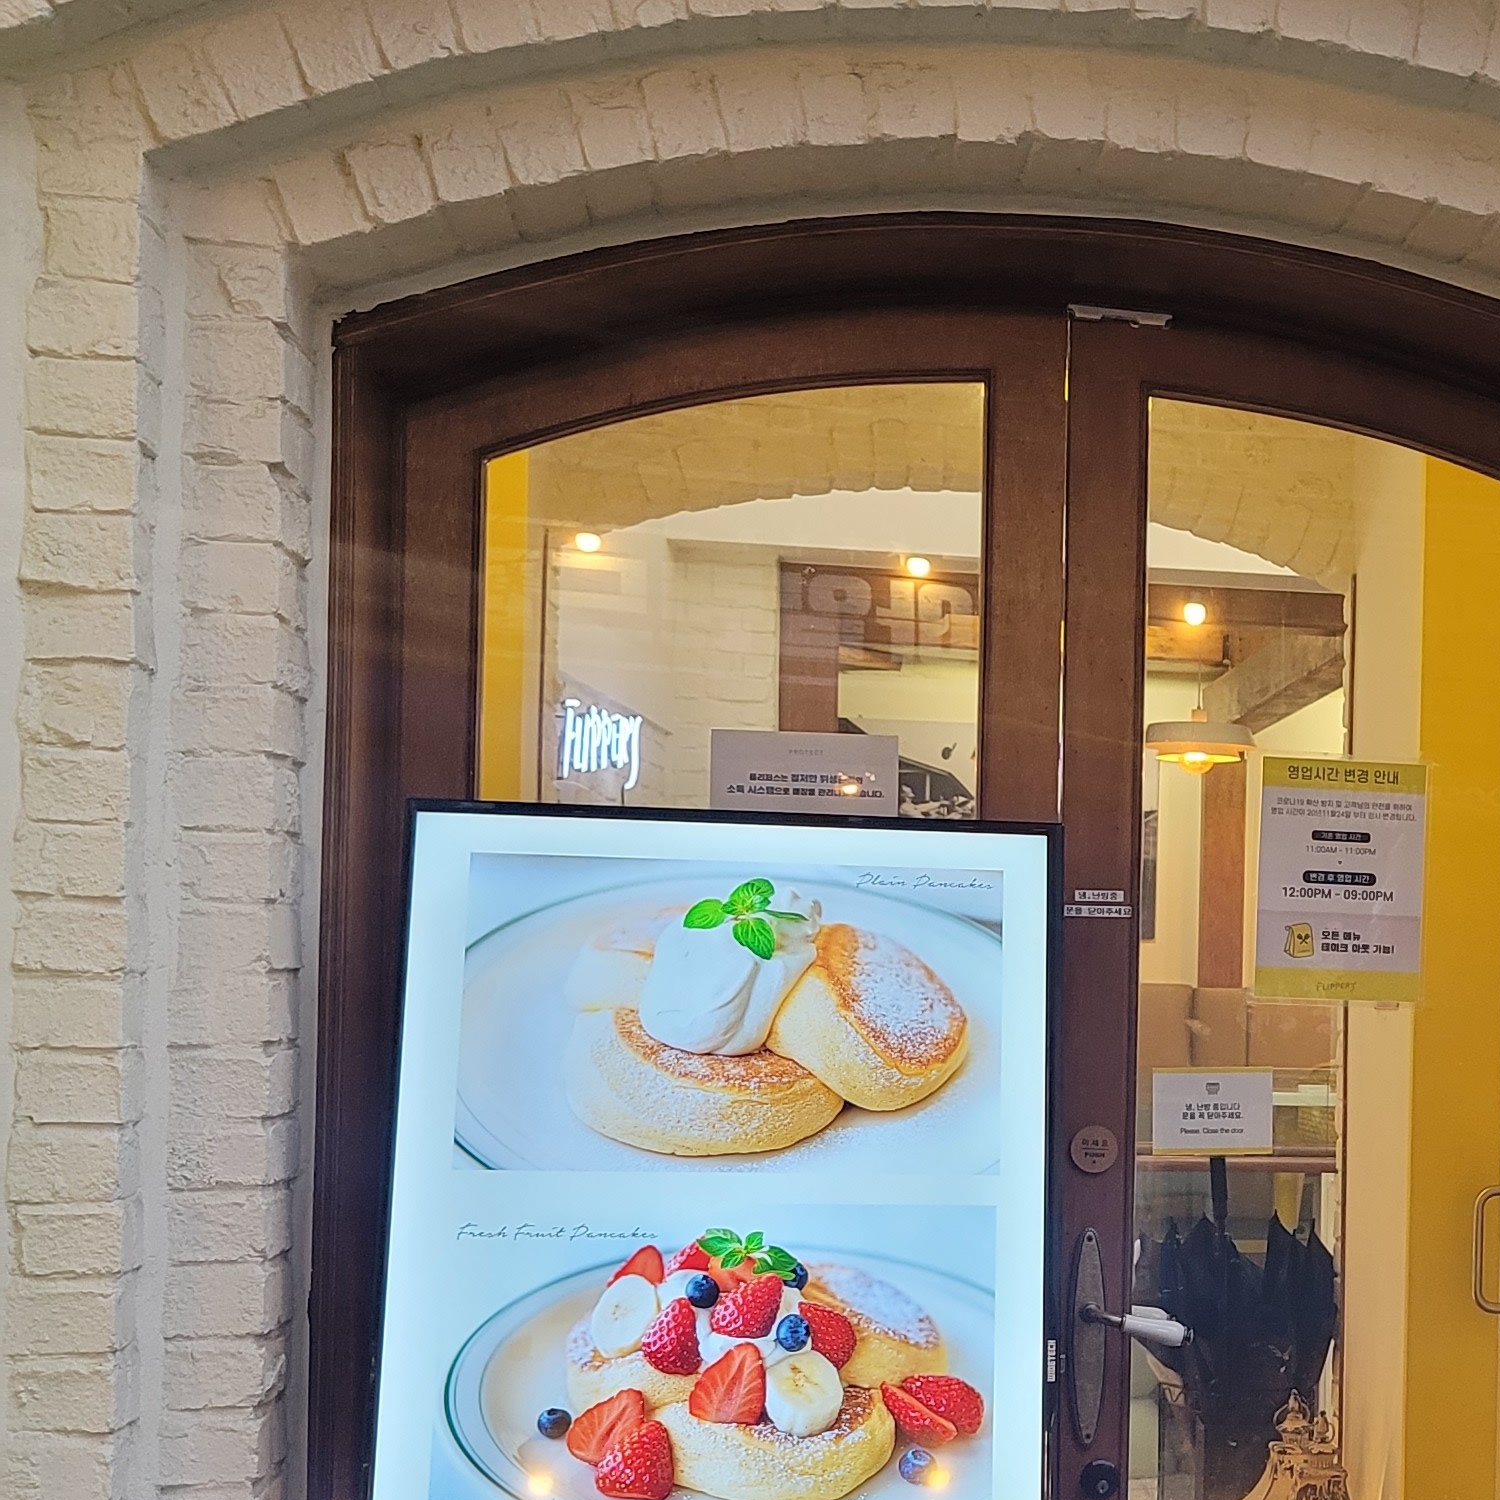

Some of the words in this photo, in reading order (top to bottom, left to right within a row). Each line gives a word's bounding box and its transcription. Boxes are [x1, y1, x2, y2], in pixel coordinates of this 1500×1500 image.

[749, 773, 789, 782] 플리퍼스는
[1287, 764, 1340, 782] 영업시간
[1344, 768, 1369, 784] 변경
[1373, 769, 1400, 785] 안내
[727, 784, 745, 794] 소독
[747, 786, 790, 795] 시스템으로
[1277, 797, 1304, 806] 코로나19
[1306, 798, 1319, 807] 확산
[1321, 799, 1334, 808] 방지
[1344, 801, 1370, 809] 고객님의
[1271, 807, 1284, 815] 영업
[1321, 832, 1333, 840] 기존
[1306, 845, 1337, 854] 11:00AM
[1345, 847, 1376, 855] 11:00PM
[855, 871, 907, 888] Plain
[912, 873, 995, 890] Pancakes
[1310, 873, 1325, 882] 변경
[1327, 873, 1334, 882] 후
[1337, 874, 1352, 883] 영업
[1354, 875, 1370, 883] 시간
[1282, 887, 1332, 899] 12:00PM
[1343, 889, 1394, 902] 09:00PM
[1066, 906, 1082, 915] 문을
[1321, 931, 1339, 941] 모든
[1343, 931, 1361, 941] 메뉴
[1321, 943, 1348, 953] 테이크
[1352, 944, 1370, 954] 아웃
[1373, 944, 1395, 954] 가능!
[1196, 1103, 1211, 1111] 난방
[1212, 1103, 1240, 1111] 중입니다
[1182, 1112, 1196, 1120] 문을
[456, 1222, 508, 1240] Fresh
[513, 1222, 566, 1241] Fruit
[569, 1223, 660, 1241] Pancakes
